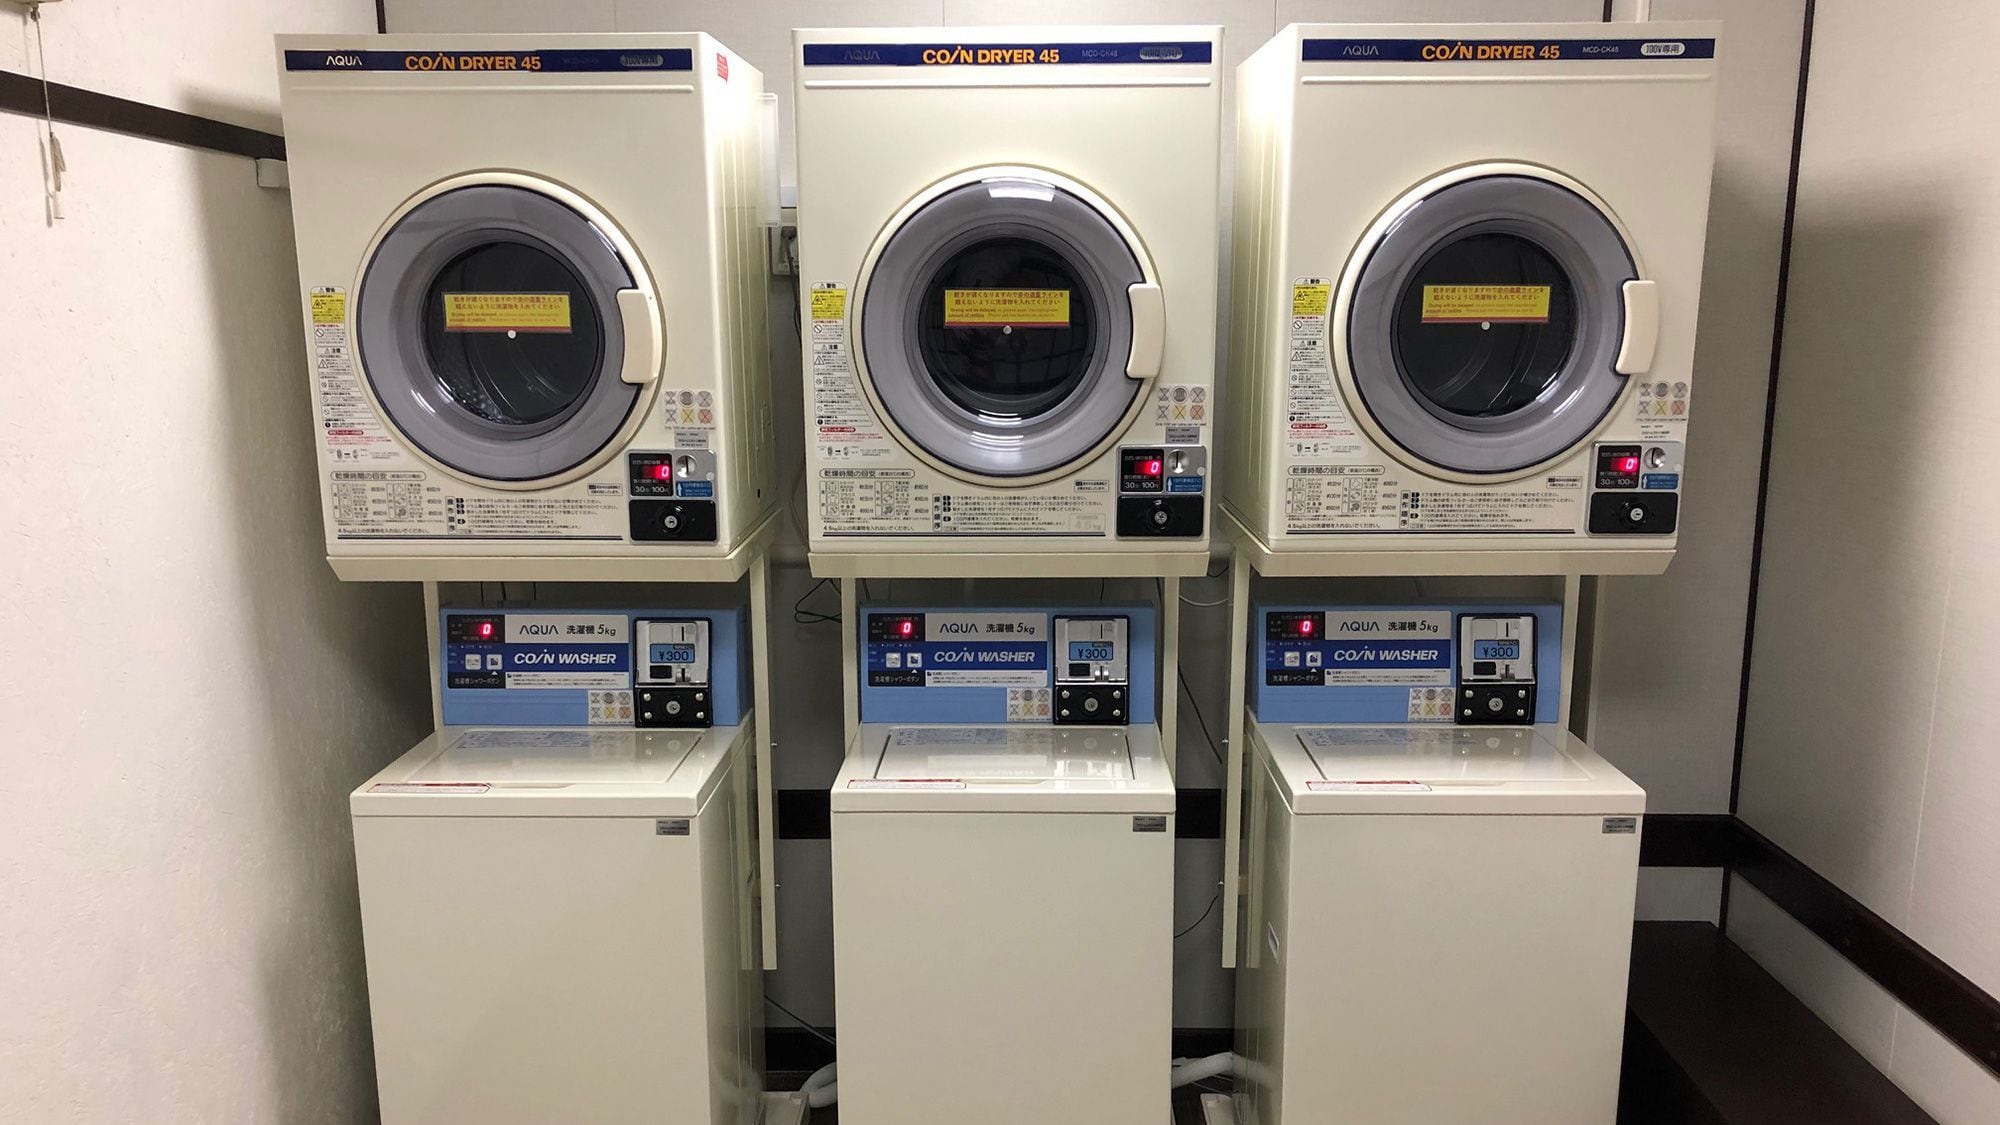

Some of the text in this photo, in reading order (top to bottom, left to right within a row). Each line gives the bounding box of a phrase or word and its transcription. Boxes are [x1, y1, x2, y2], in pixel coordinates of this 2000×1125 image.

[977, 49, 1036, 63] DRYER
[1039, 49, 1060, 63] 45
[1343, 46, 1379, 56] AQUA
[1475, 46, 1537, 60] DRYER
[1539, 46, 1560, 59] 45
[325, 55, 362, 66] AQUA
[459, 56, 519, 70] DRYER
[521, 56, 542, 70] 45
[1150, 461, 1159, 473] 0
[1292, 466, 1345, 474] 乾燥時間の目安
[1625, 458, 1634, 470] 0
[335, 472, 387, 480] 乾燥時間の目安
[661, 465, 670, 477] 0
[483, 623, 491, 635] 0
[519, 624, 616, 636] AQUA 洗濯機 5kg
[903, 622, 912, 634] 0
[939, 622, 1035, 635] AQUA 洗濯機 5kg
[1302, 620, 1311, 632] 0
[1339, 620, 1438, 633] AQUA 洗濯機 5kg
[659, 650, 689, 662] ¥300
[978, 652, 1036, 662] WASHER
[1077, 648, 1107, 660] ¥300
[1380, 650, 1438, 660] WASHER
[1483, 646, 1513, 658] ¥300
[559, 653, 616, 664] WASHER
